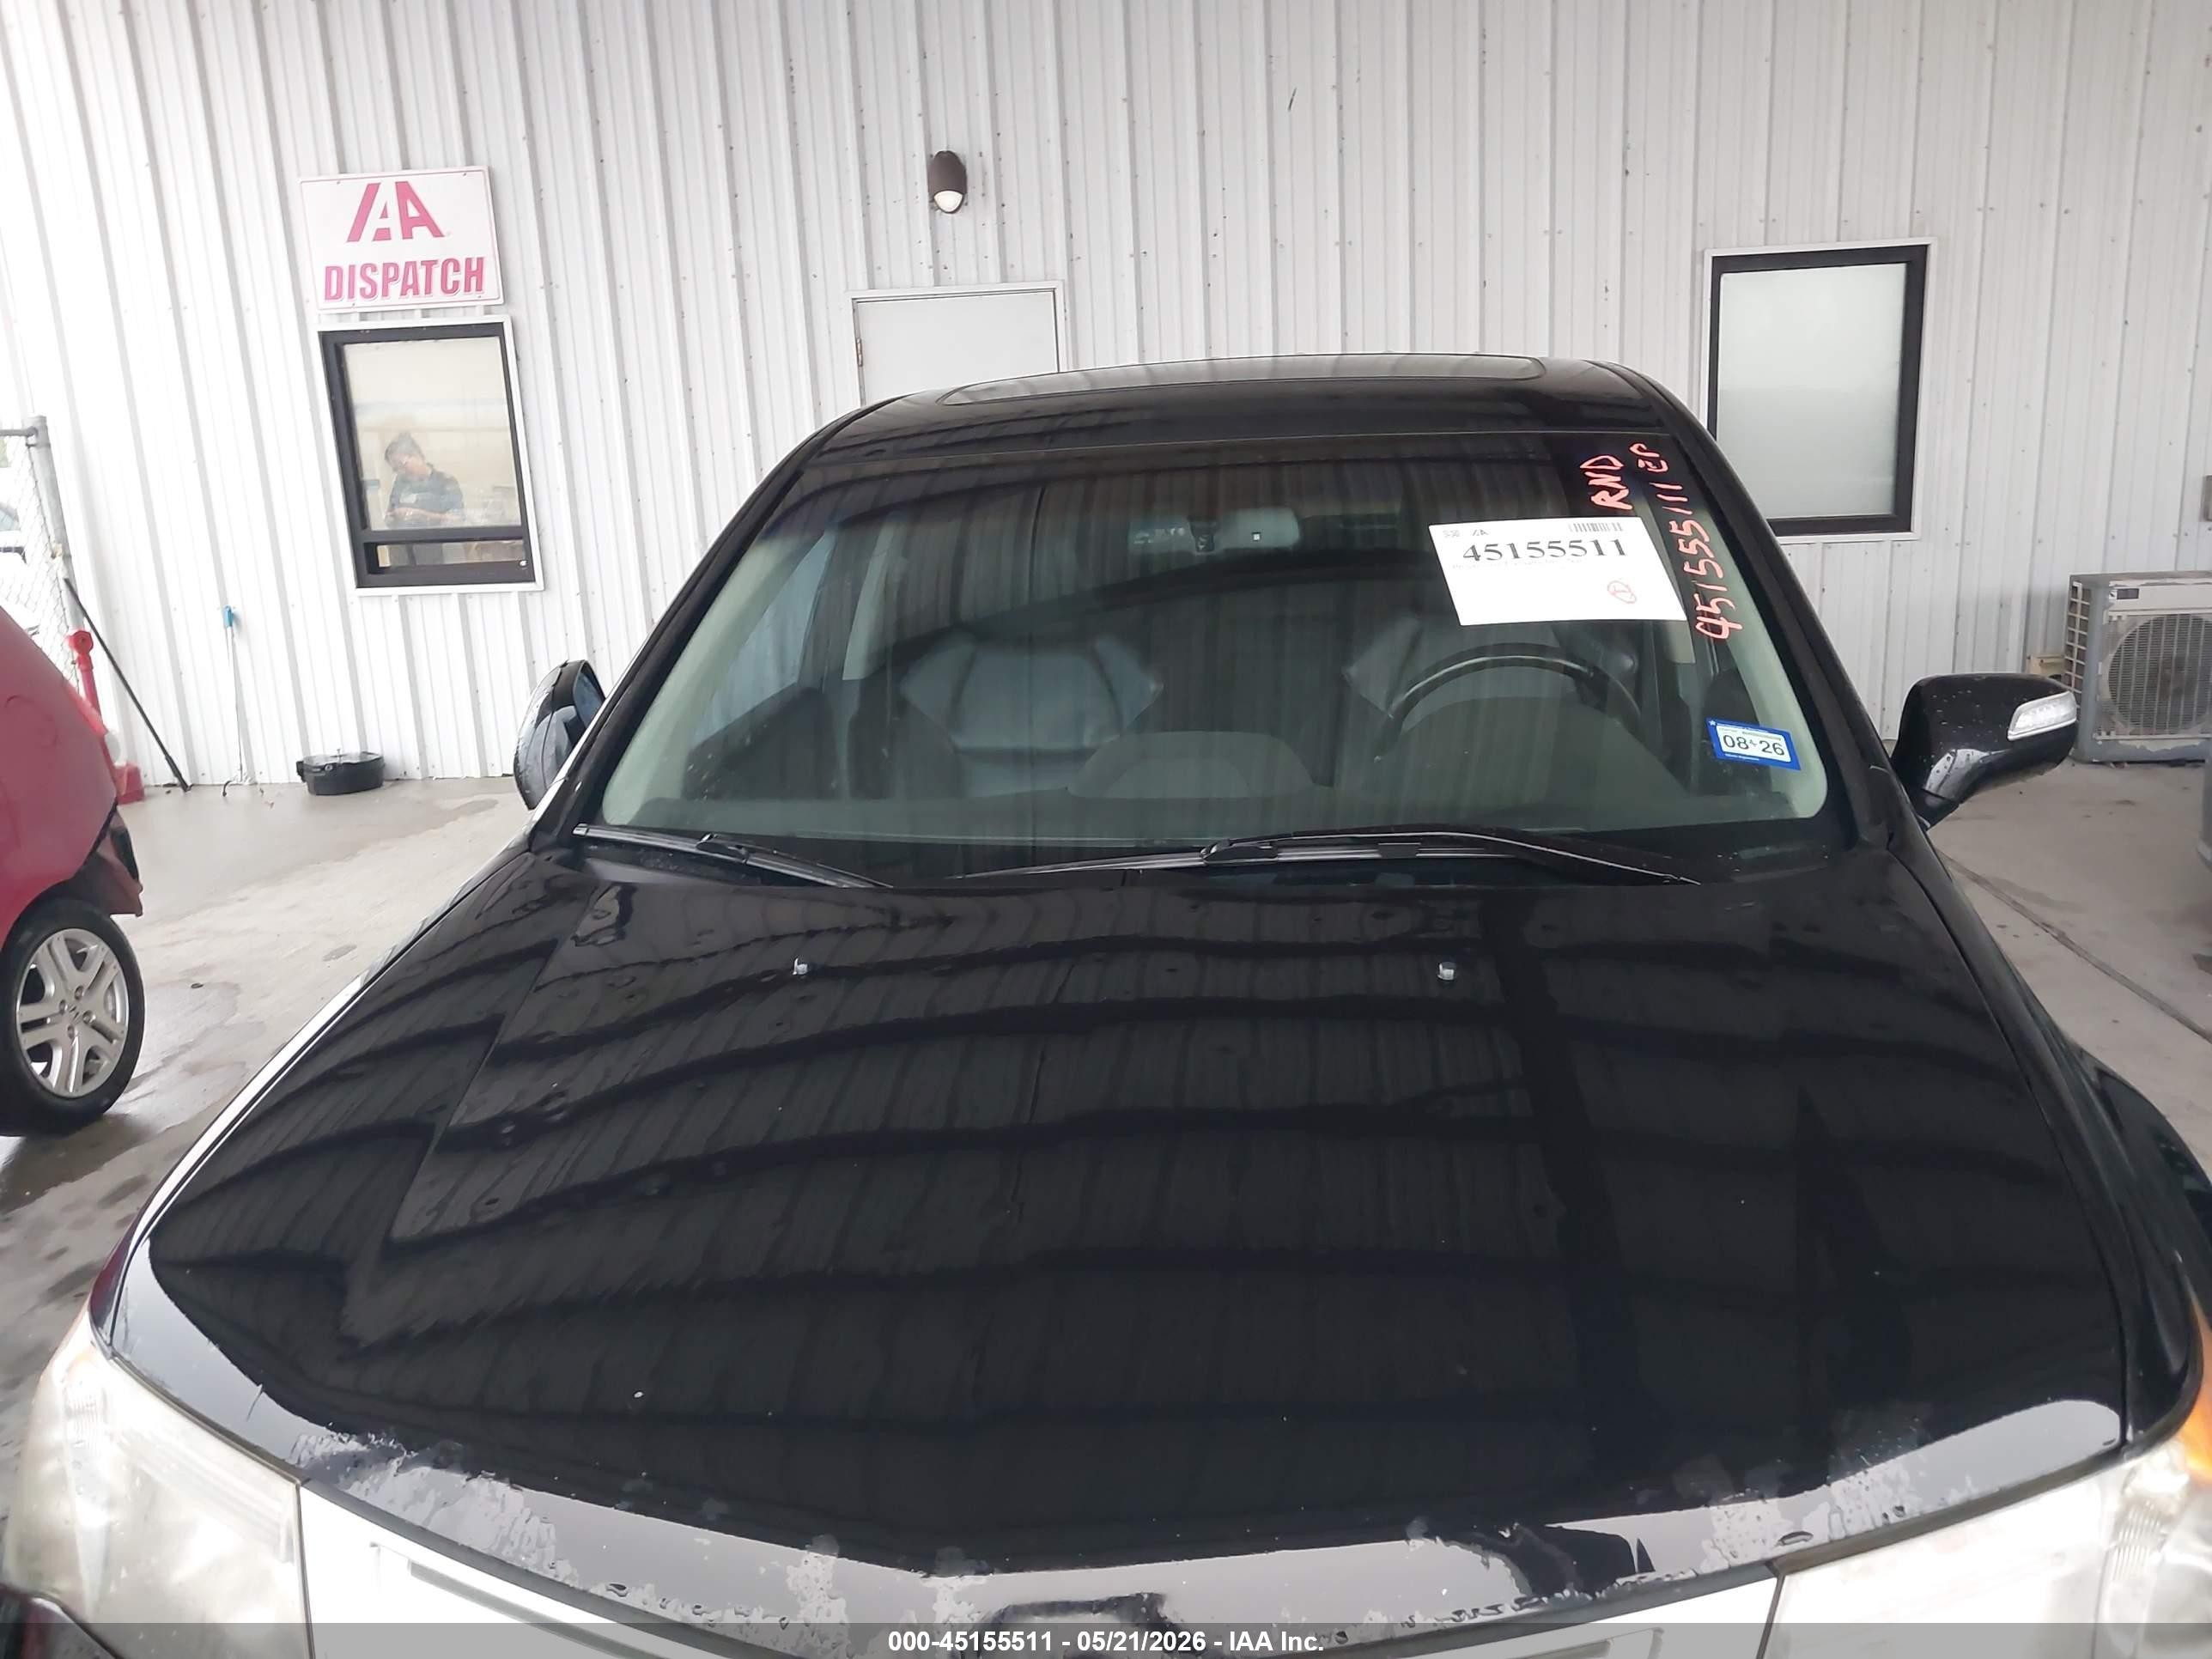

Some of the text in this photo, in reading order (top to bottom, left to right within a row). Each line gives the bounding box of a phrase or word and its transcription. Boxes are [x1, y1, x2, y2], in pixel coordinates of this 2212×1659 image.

[324, 257, 485, 301] DISPATCH
[1462, 538, 1626, 562] 45155511
[1723, 734, 1749, 750] 08
[1759, 740, 1785, 757] 26
